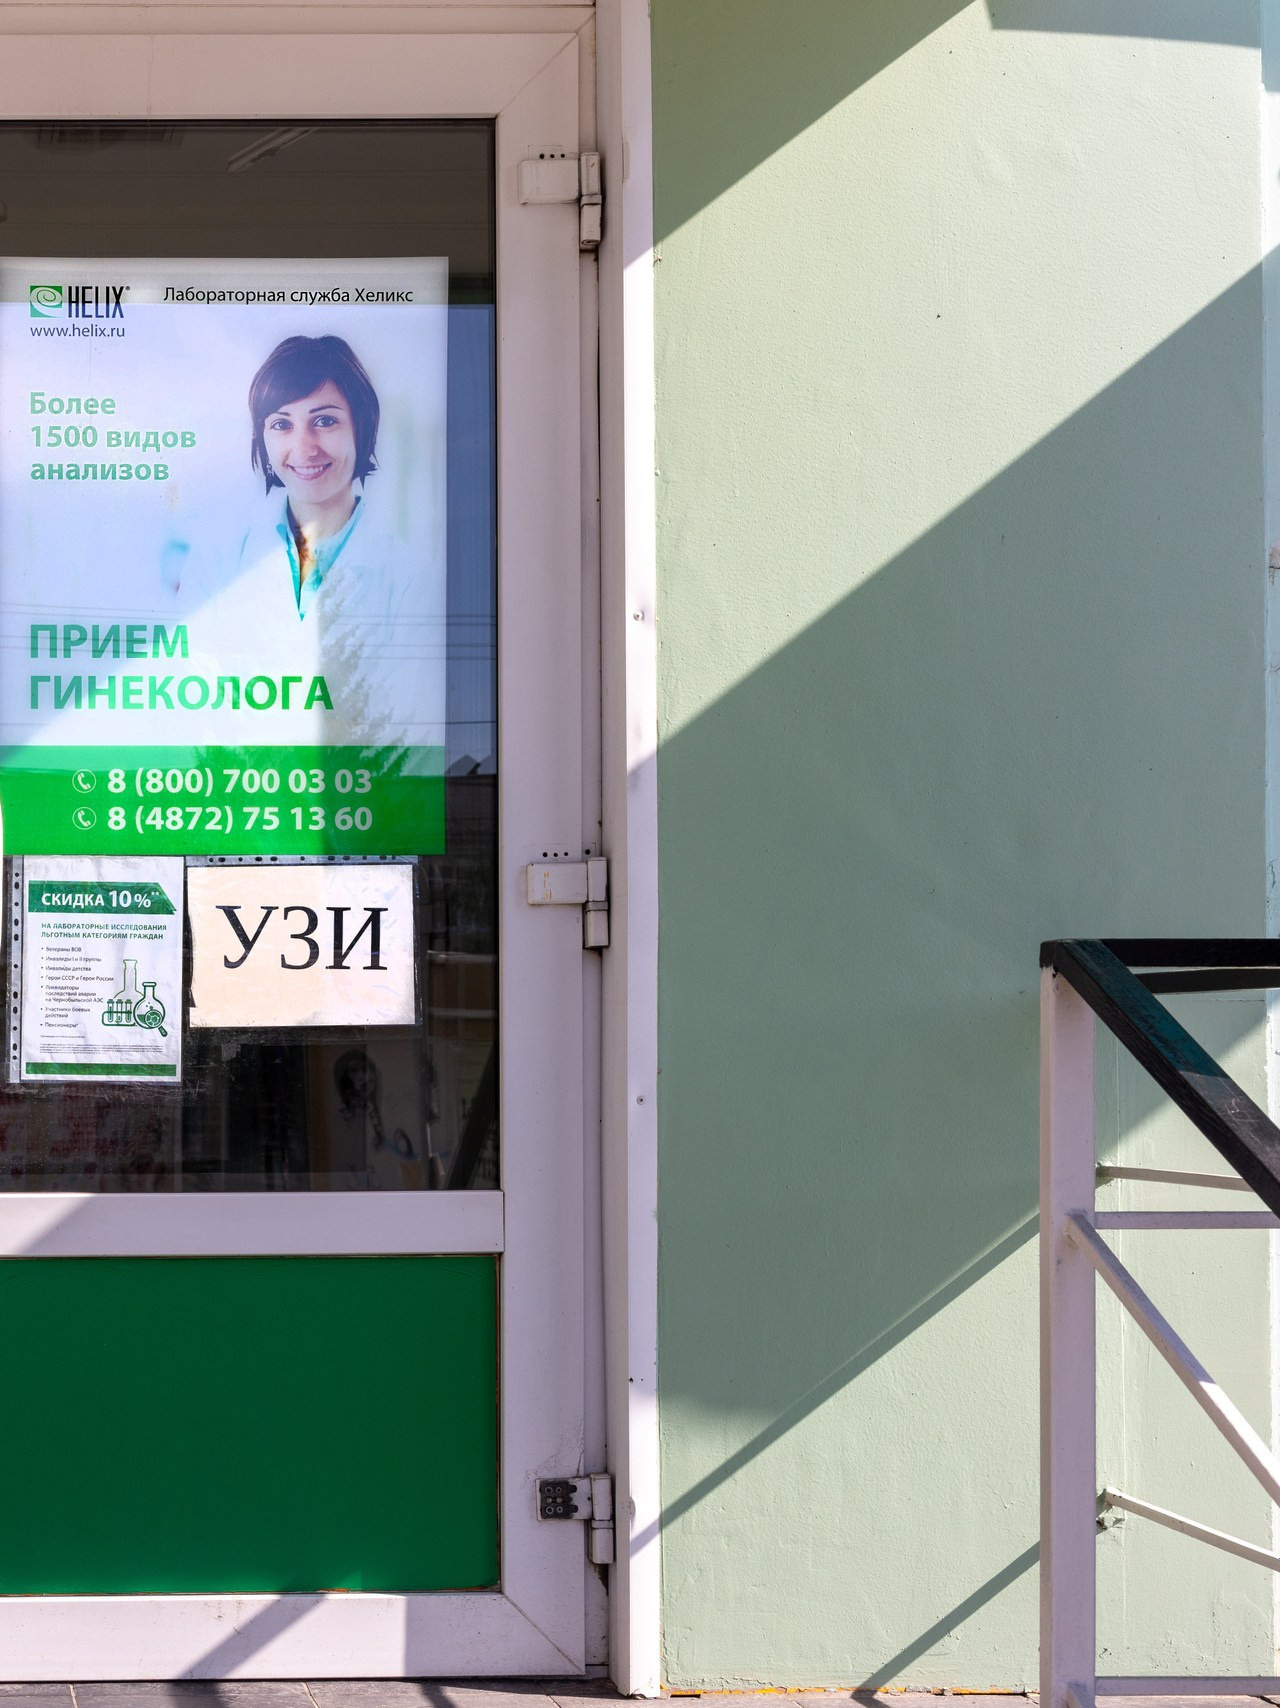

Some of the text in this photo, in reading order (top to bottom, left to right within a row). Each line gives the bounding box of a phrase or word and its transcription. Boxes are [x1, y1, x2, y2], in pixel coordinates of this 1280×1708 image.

[67, 285, 126, 319] HELIX
[163, 287, 414, 307] Лабораторная служба Хеликс
[29, 324, 126, 338] www.helix.ru
[29, 391, 116, 415] Более
[30, 425, 197, 453] 1500 видов
[30, 463, 170, 482] анализов
[29, 624, 190, 659] ПРИЕМ
[29, 675, 334, 710] ГИНЕКОЛОГА
[107, 767, 372, 798] 8 (800) 700 03 03
[107, 805, 373, 835] 8 (4872) 75 13 60
[41, 893, 105, 909] СКИДКА
[41, 931, 80, 939] ЛЬГОТНЫМ
[215, 904, 389, 970] УЗИ
